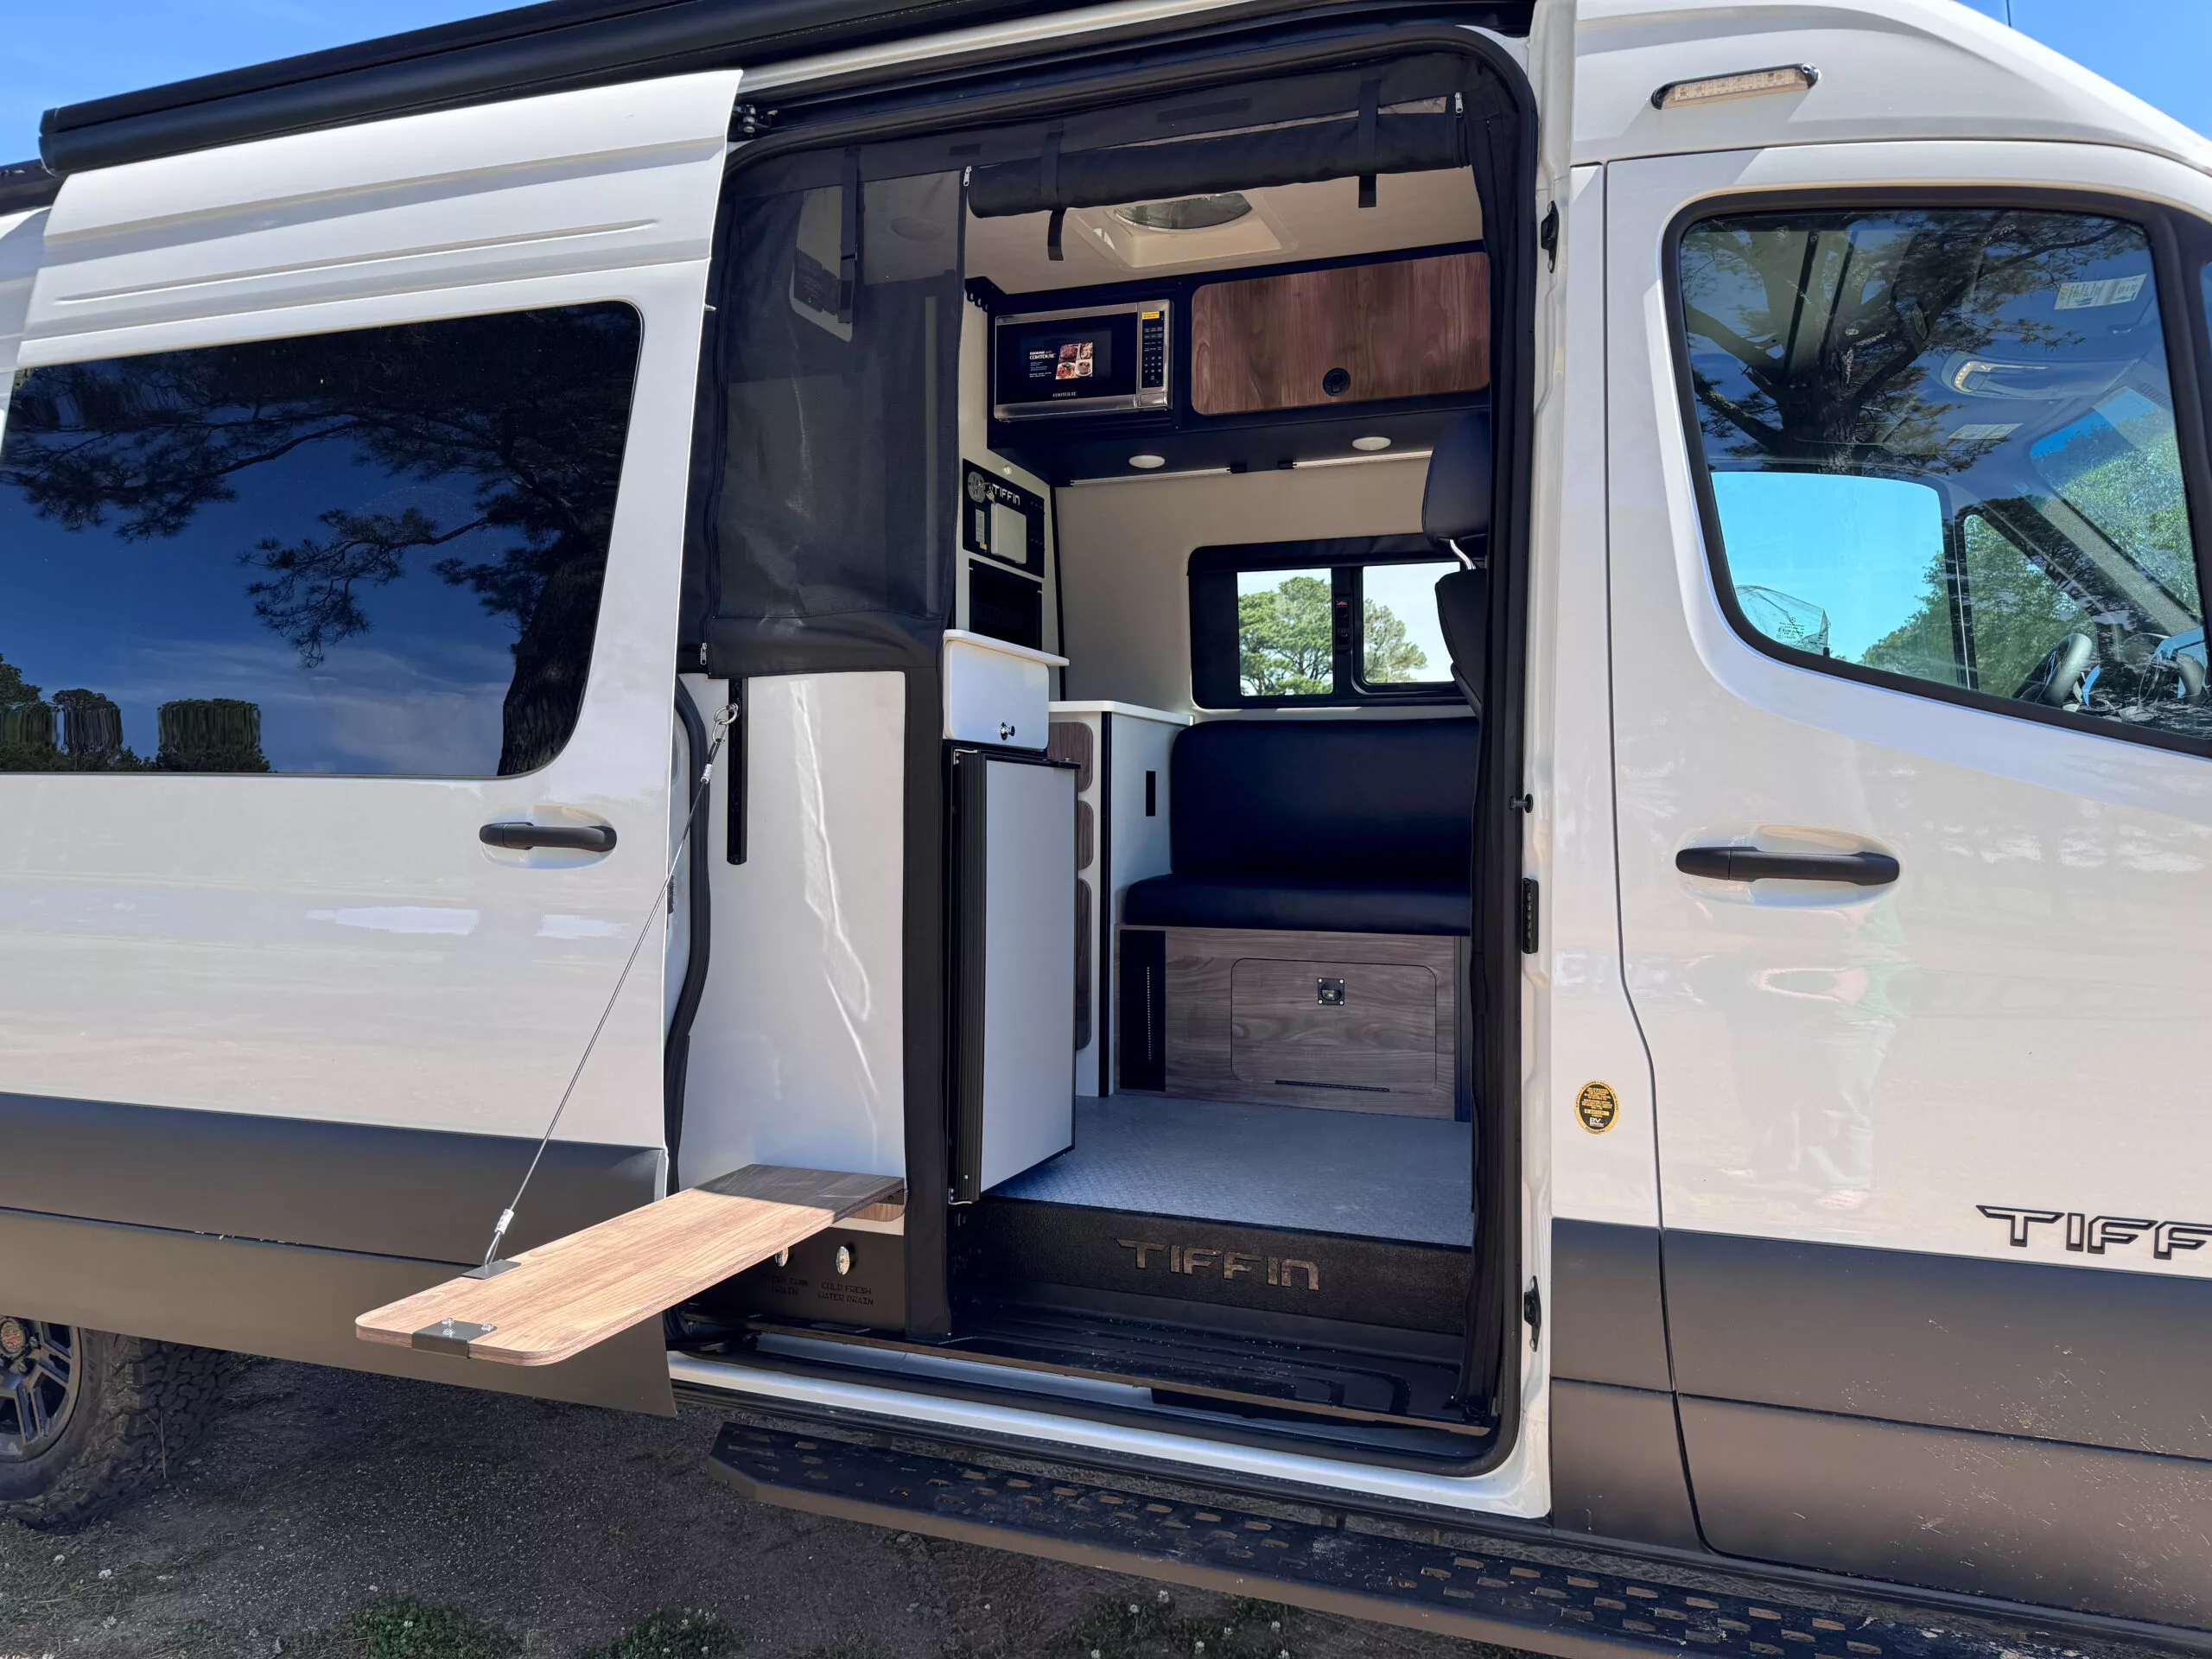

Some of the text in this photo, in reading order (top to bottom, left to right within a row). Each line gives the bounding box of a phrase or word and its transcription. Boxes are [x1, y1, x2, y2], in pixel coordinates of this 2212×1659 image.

[992, 483, 1020, 505] TIFFIN
[1975, 1205, 2212, 1260] TIFF
[1114, 1238, 1319, 1291] TIFFIN
[817, 1291, 874, 1306] WATER DRAIN
[821, 1281, 872, 1295] COLD FRESH
